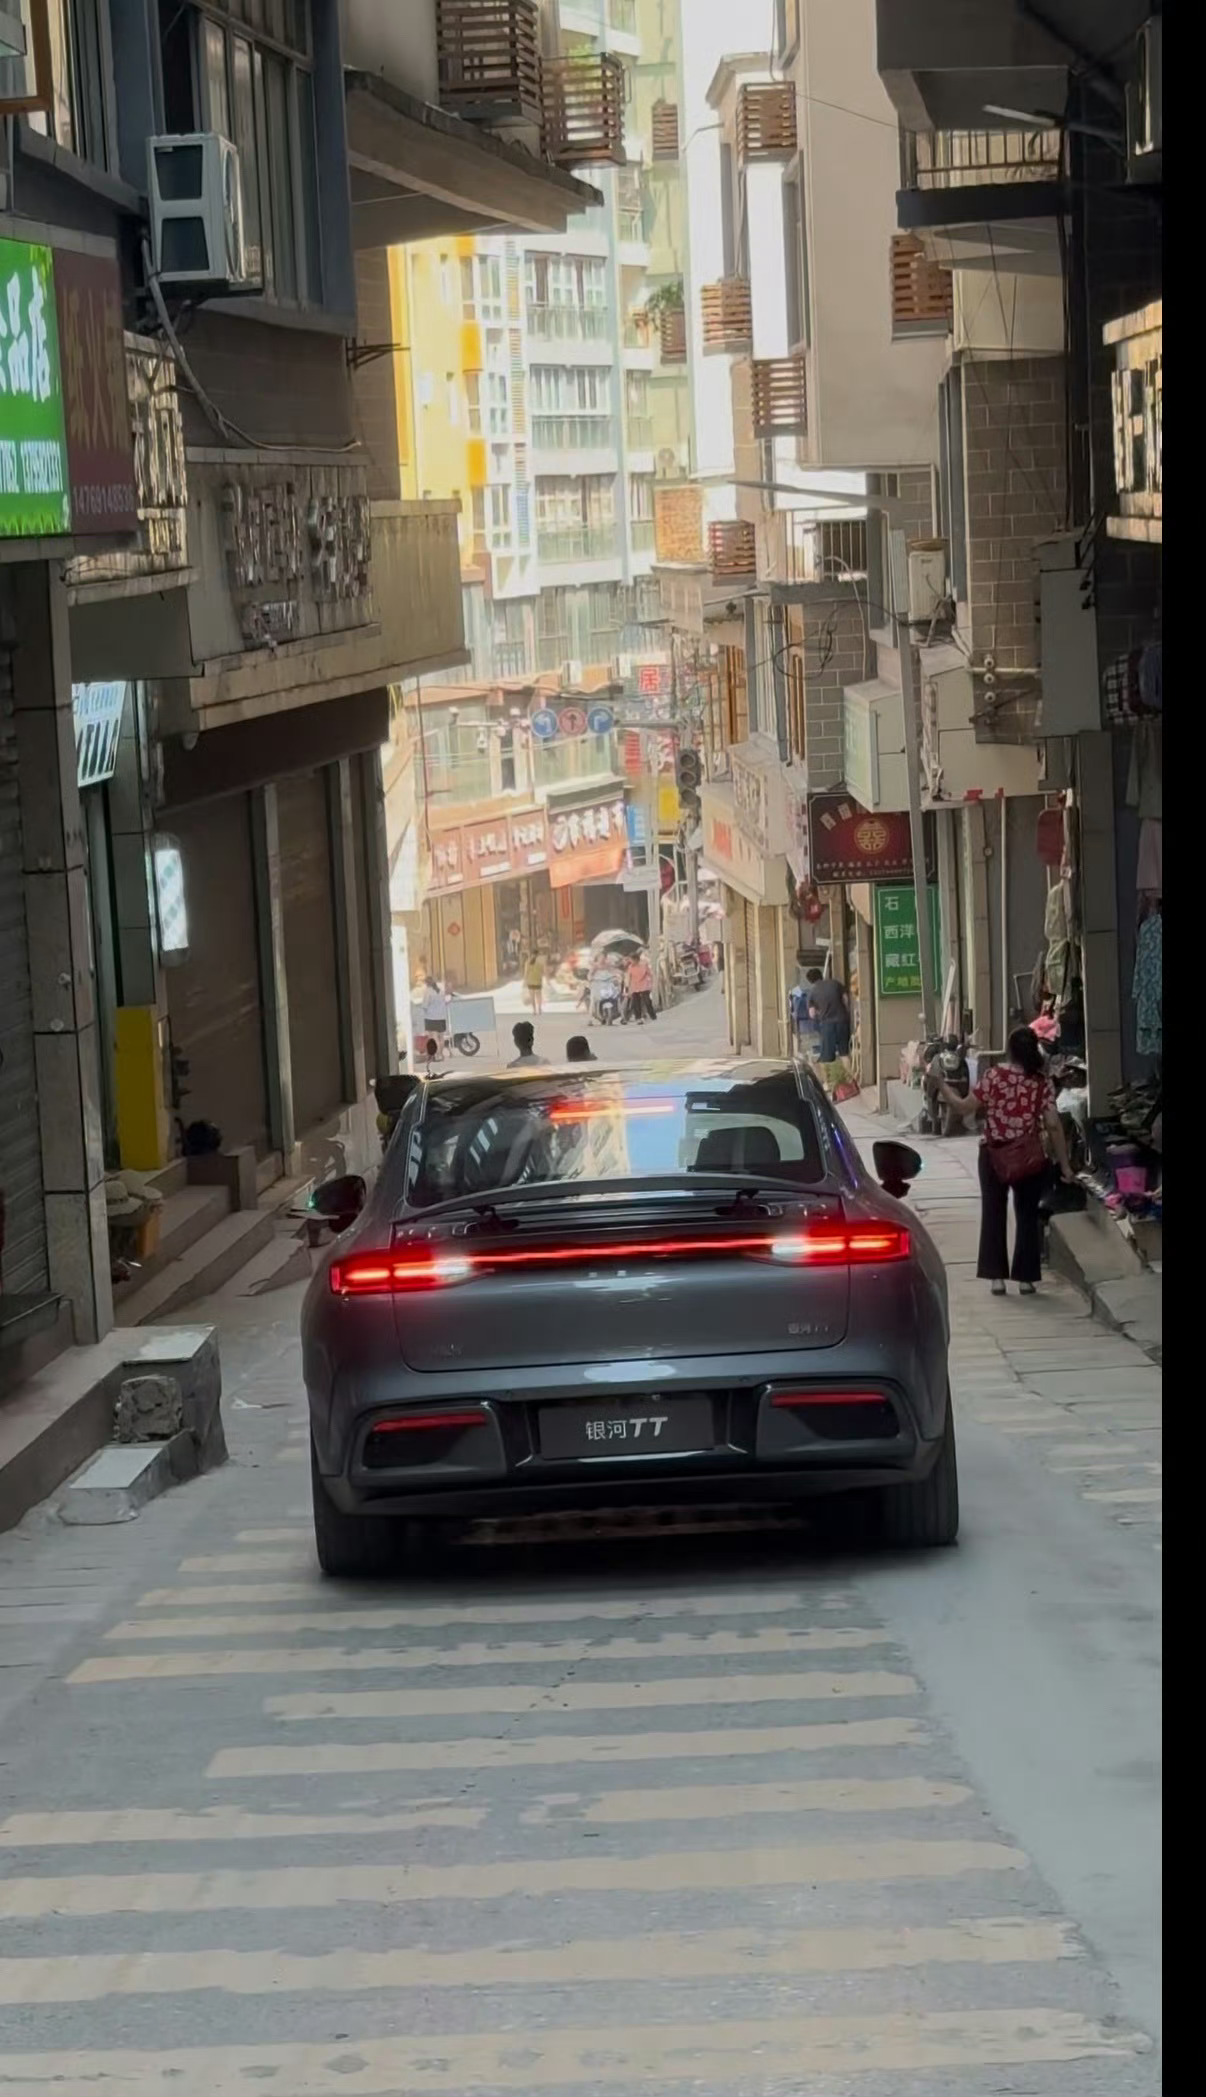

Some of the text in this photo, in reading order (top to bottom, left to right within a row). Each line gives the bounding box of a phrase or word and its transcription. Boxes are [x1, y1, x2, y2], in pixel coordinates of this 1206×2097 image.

[882, 920, 914, 940] 西洋
[884, 952, 921, 968] 藏红
[585, 1416, 669, 1440] 银河TT
